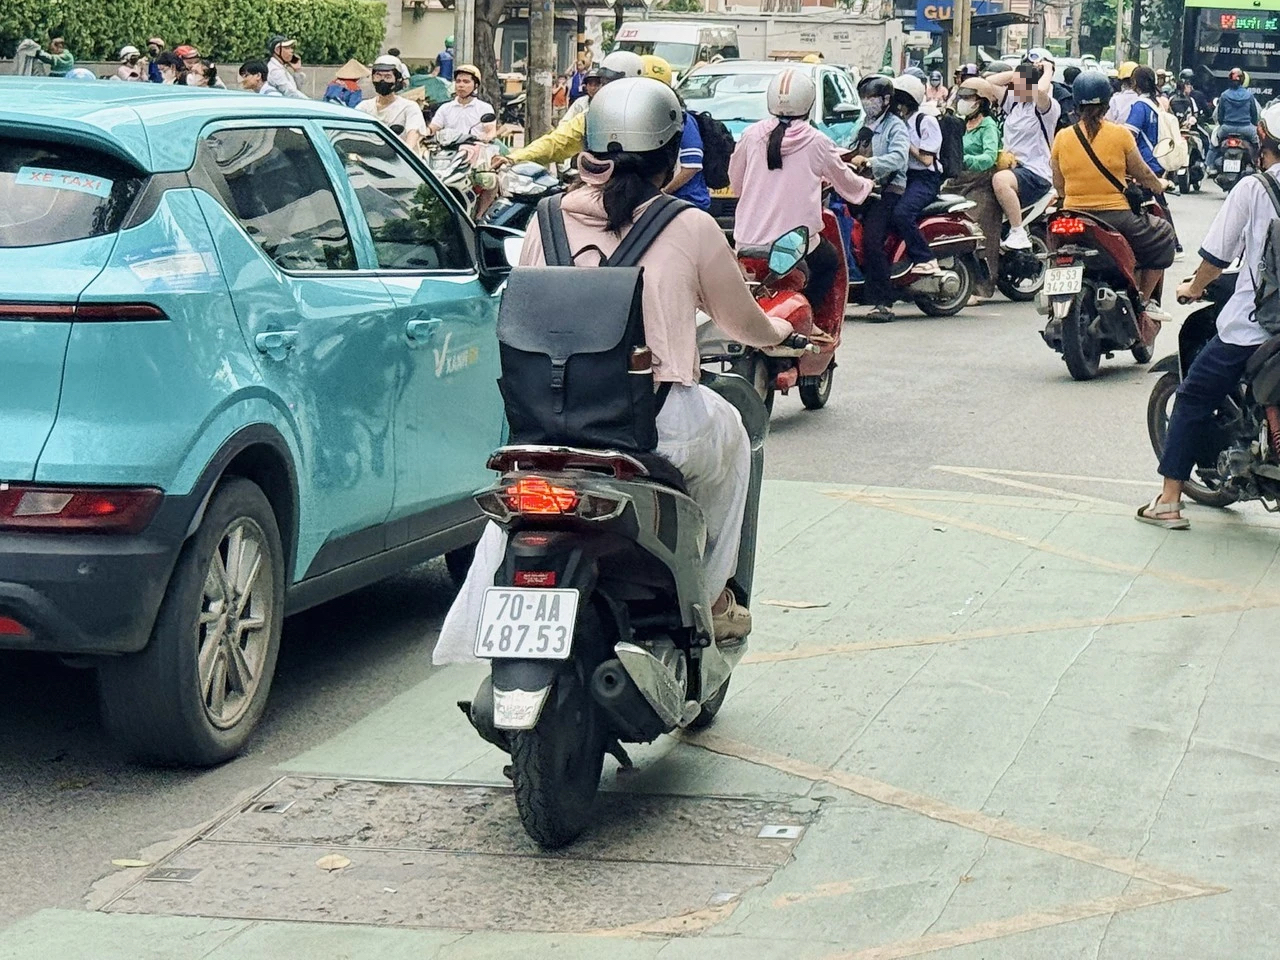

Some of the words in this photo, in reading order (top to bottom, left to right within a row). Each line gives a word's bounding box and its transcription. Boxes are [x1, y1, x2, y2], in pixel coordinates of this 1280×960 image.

[31, 170, 54, 182] XE
[61, 174, 102, 190] TAXI
[496, 593, 561, 622] 70-AA
[482, 624, 567, 653] 487.53
